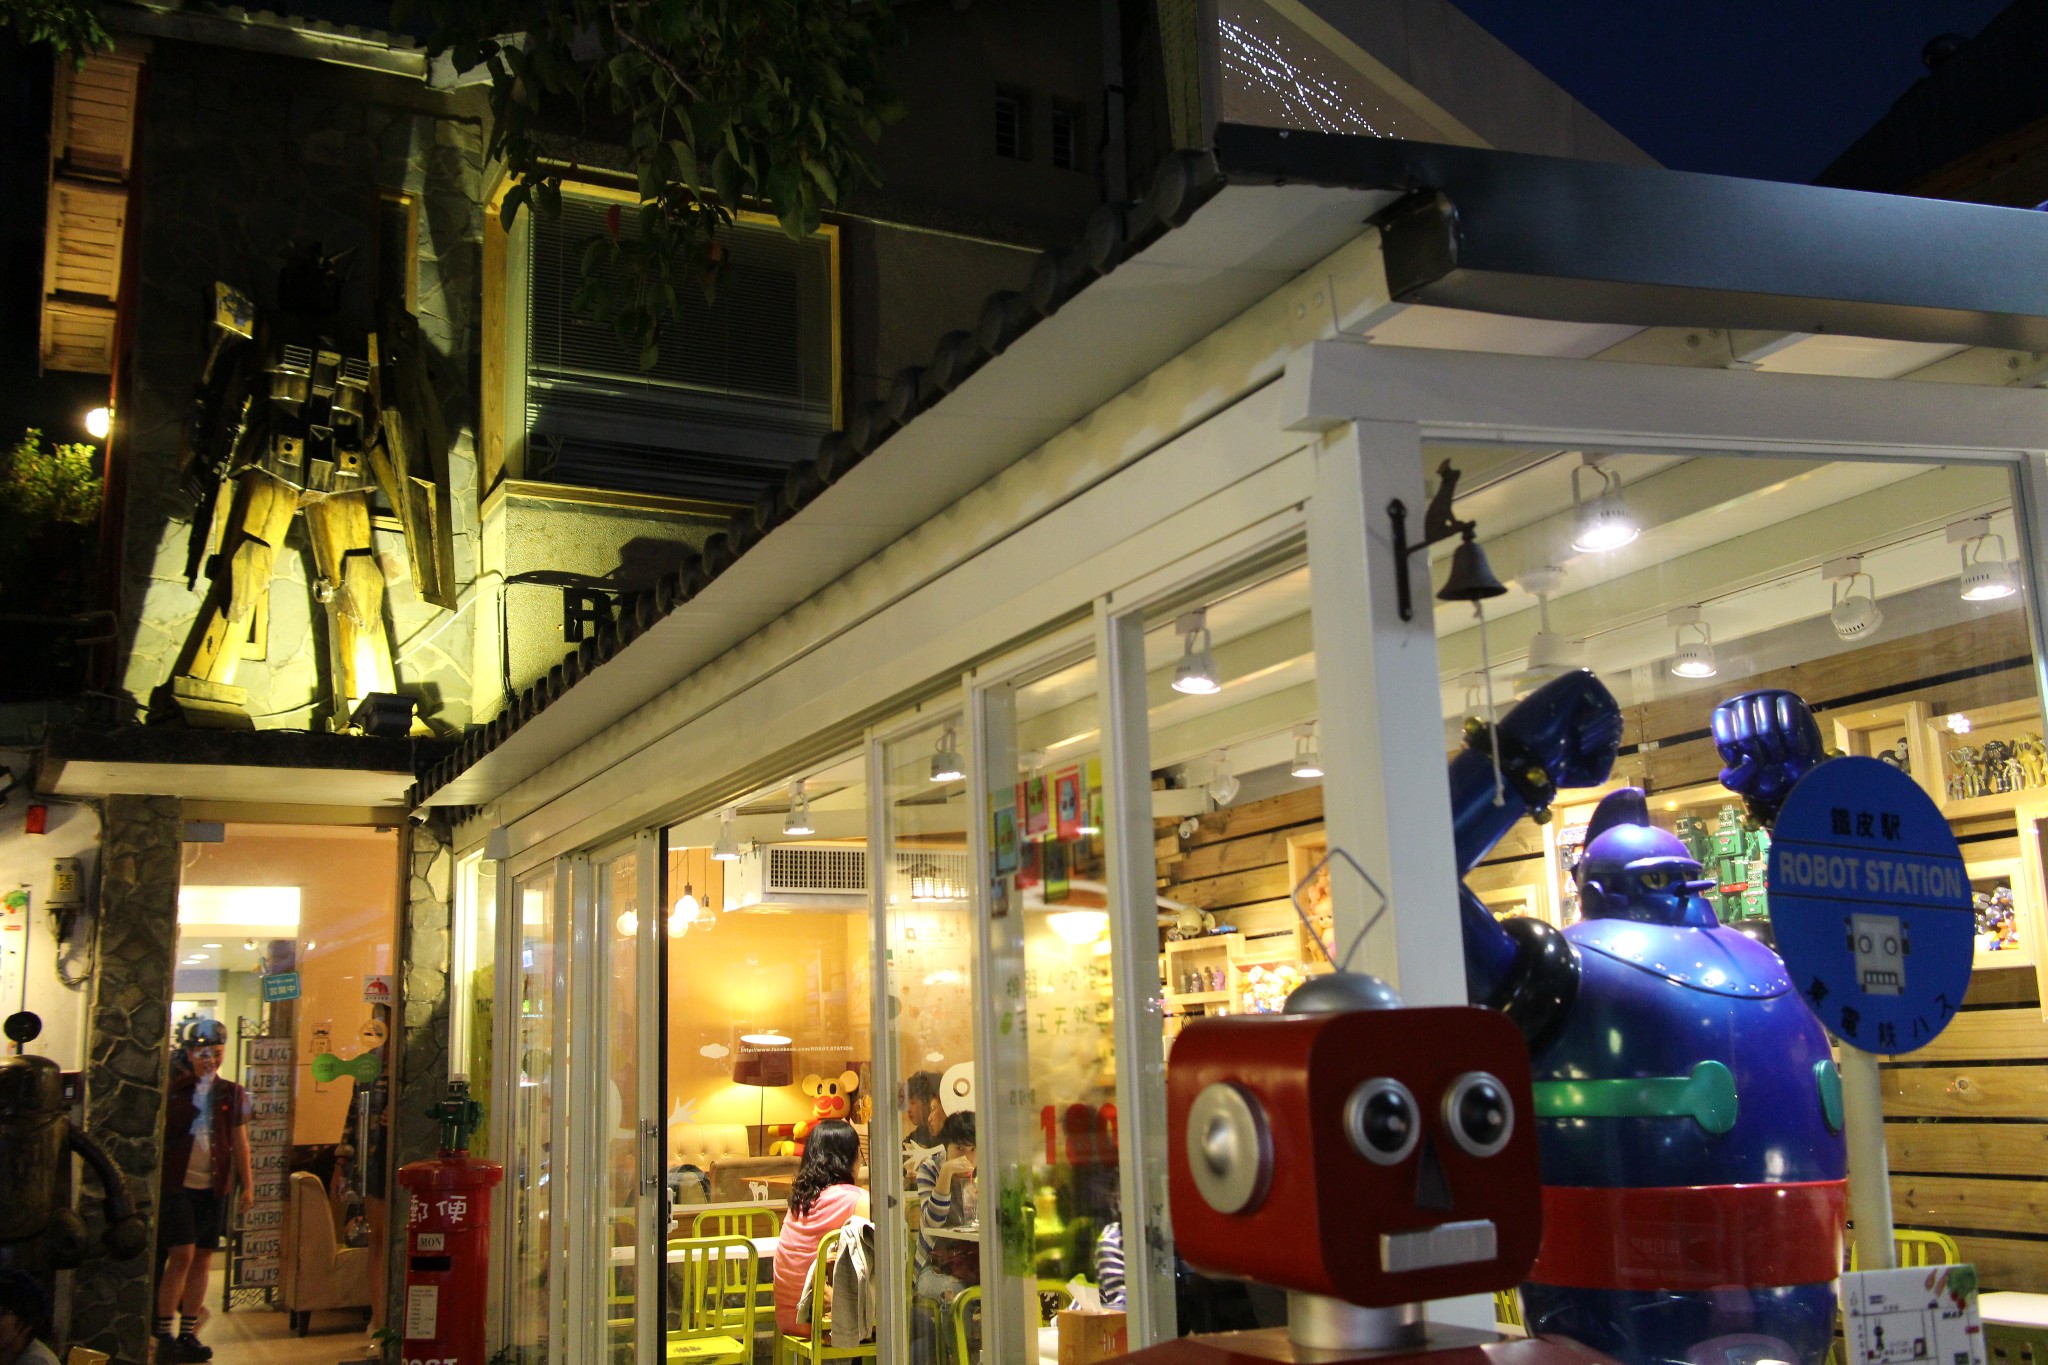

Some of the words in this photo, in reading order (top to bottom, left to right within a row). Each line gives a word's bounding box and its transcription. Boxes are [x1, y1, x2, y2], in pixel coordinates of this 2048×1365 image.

[1779, 852, 1860, 892] ROBOT
[1865, 860, 1962, 899] STATION
[410, 1194, 467, 1224] 郵便
[420, 1237, 442, 1247] MON
